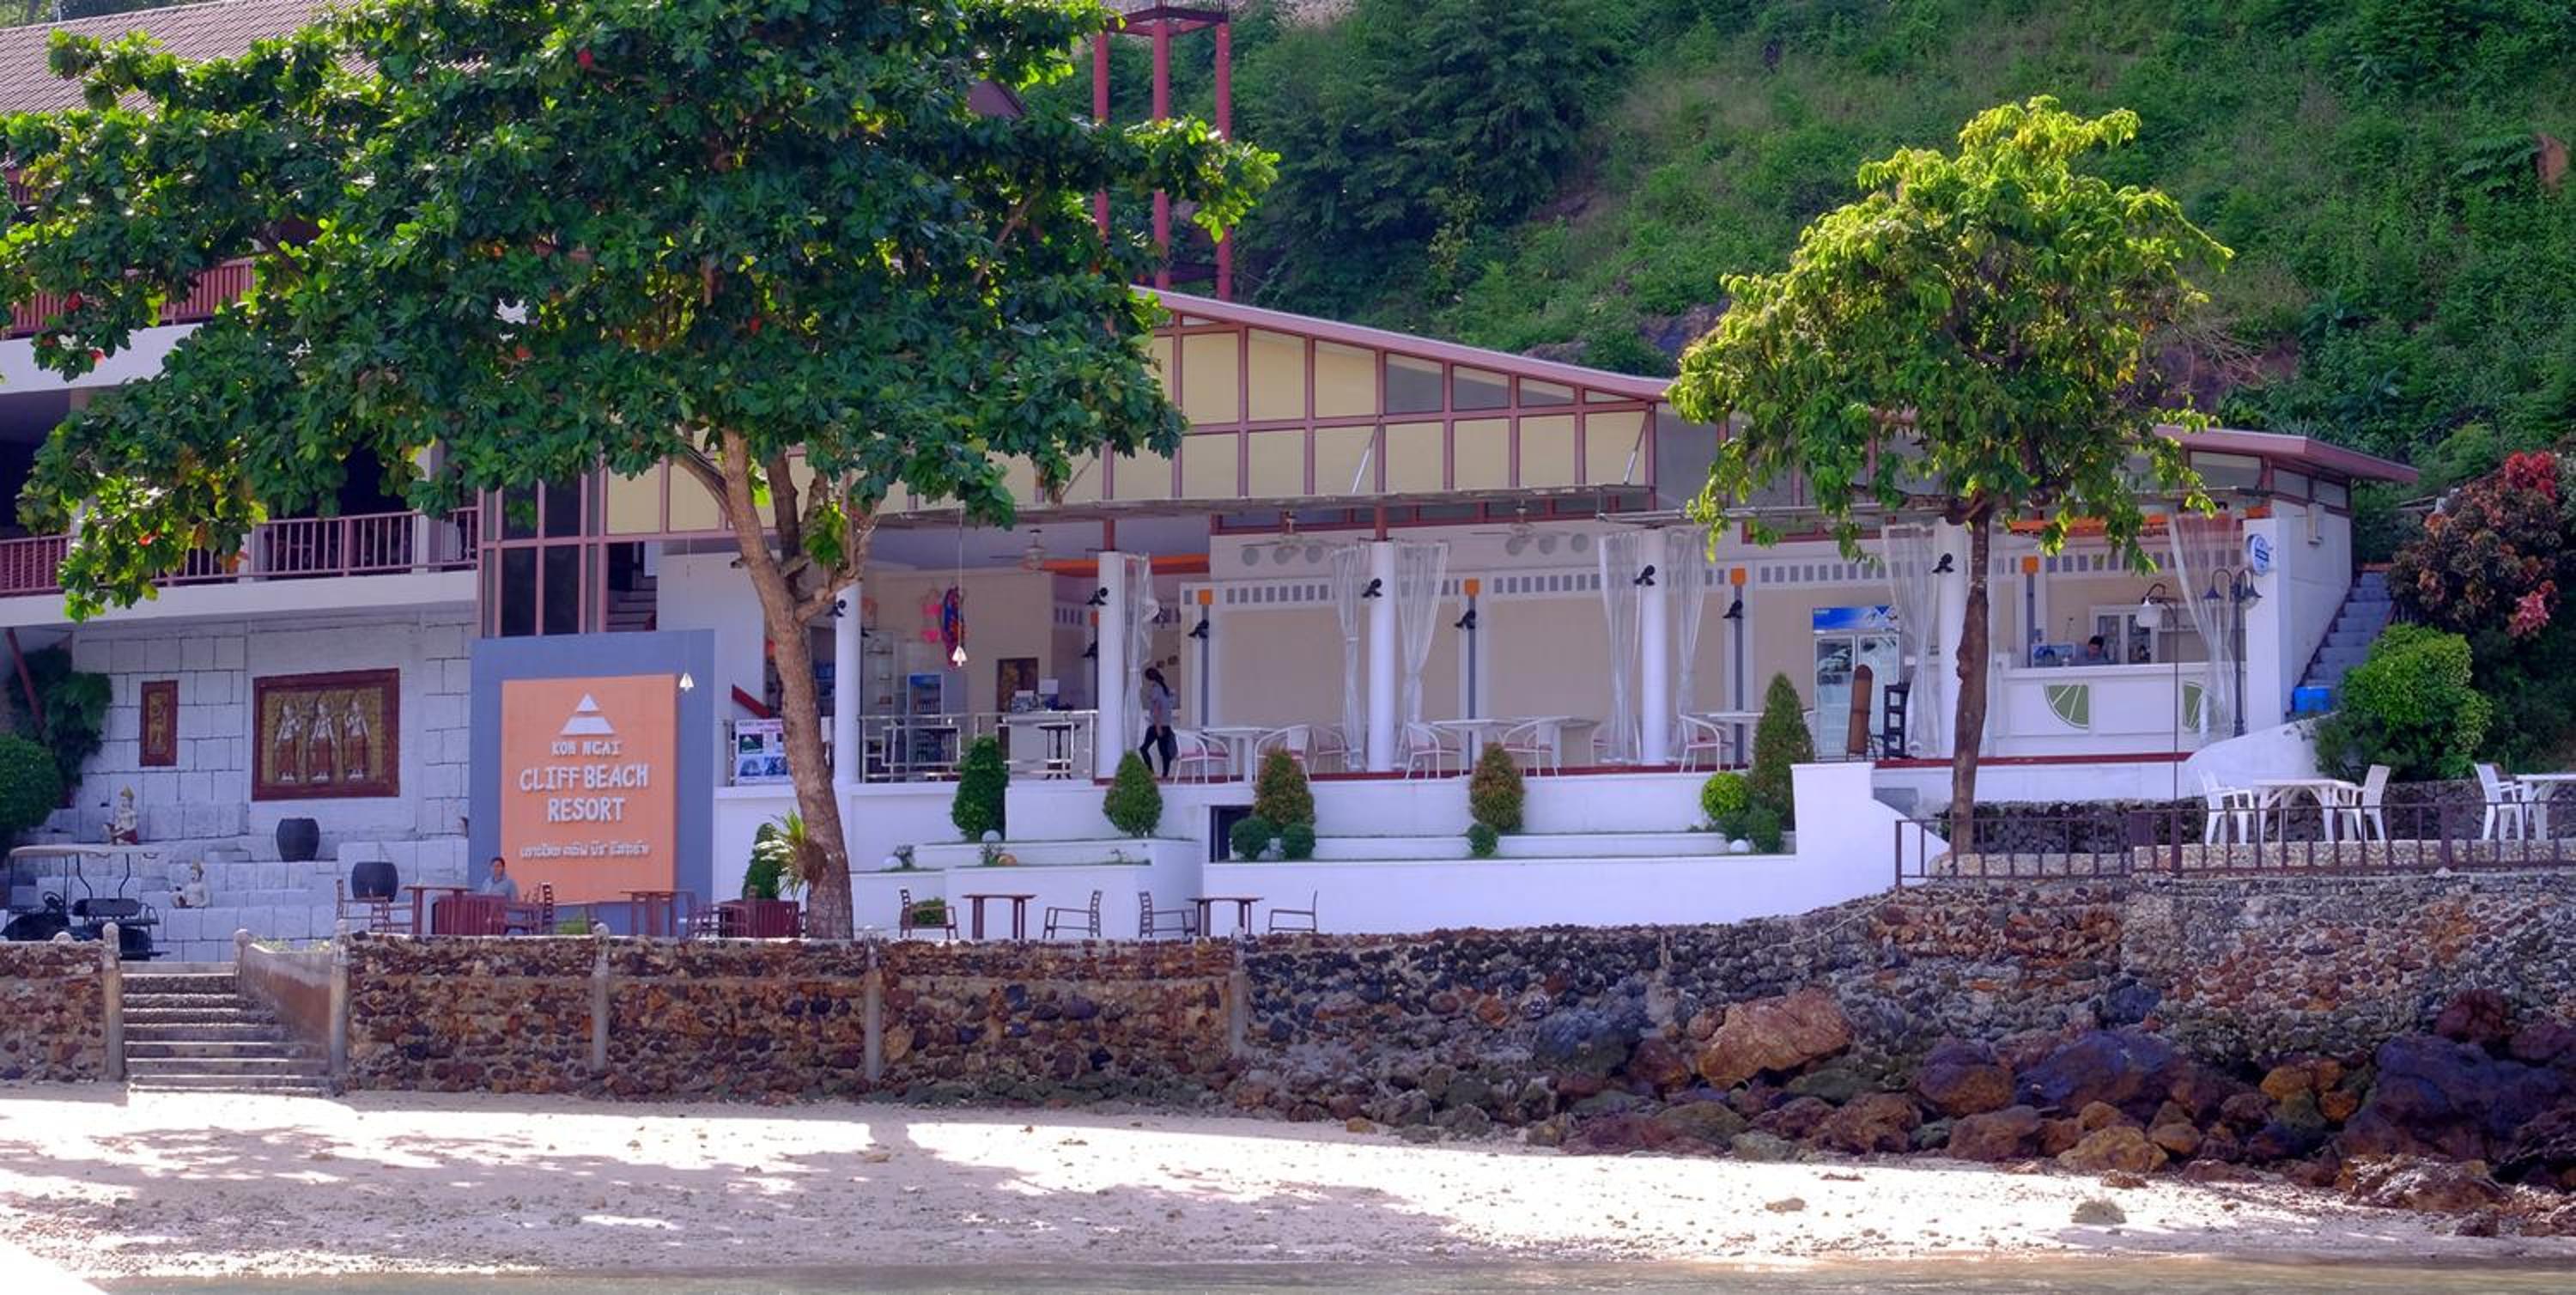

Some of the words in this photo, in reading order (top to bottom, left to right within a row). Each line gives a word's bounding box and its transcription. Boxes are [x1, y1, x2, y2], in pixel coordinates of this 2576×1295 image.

[551, 741, 576, 756] KOH
[583, 741, 623, 756] NGAI
[519, 767, 580, 792] CLIFF
[583, 763, 649, 789] BEACH
[548, 797, 625, 823] RESORT
